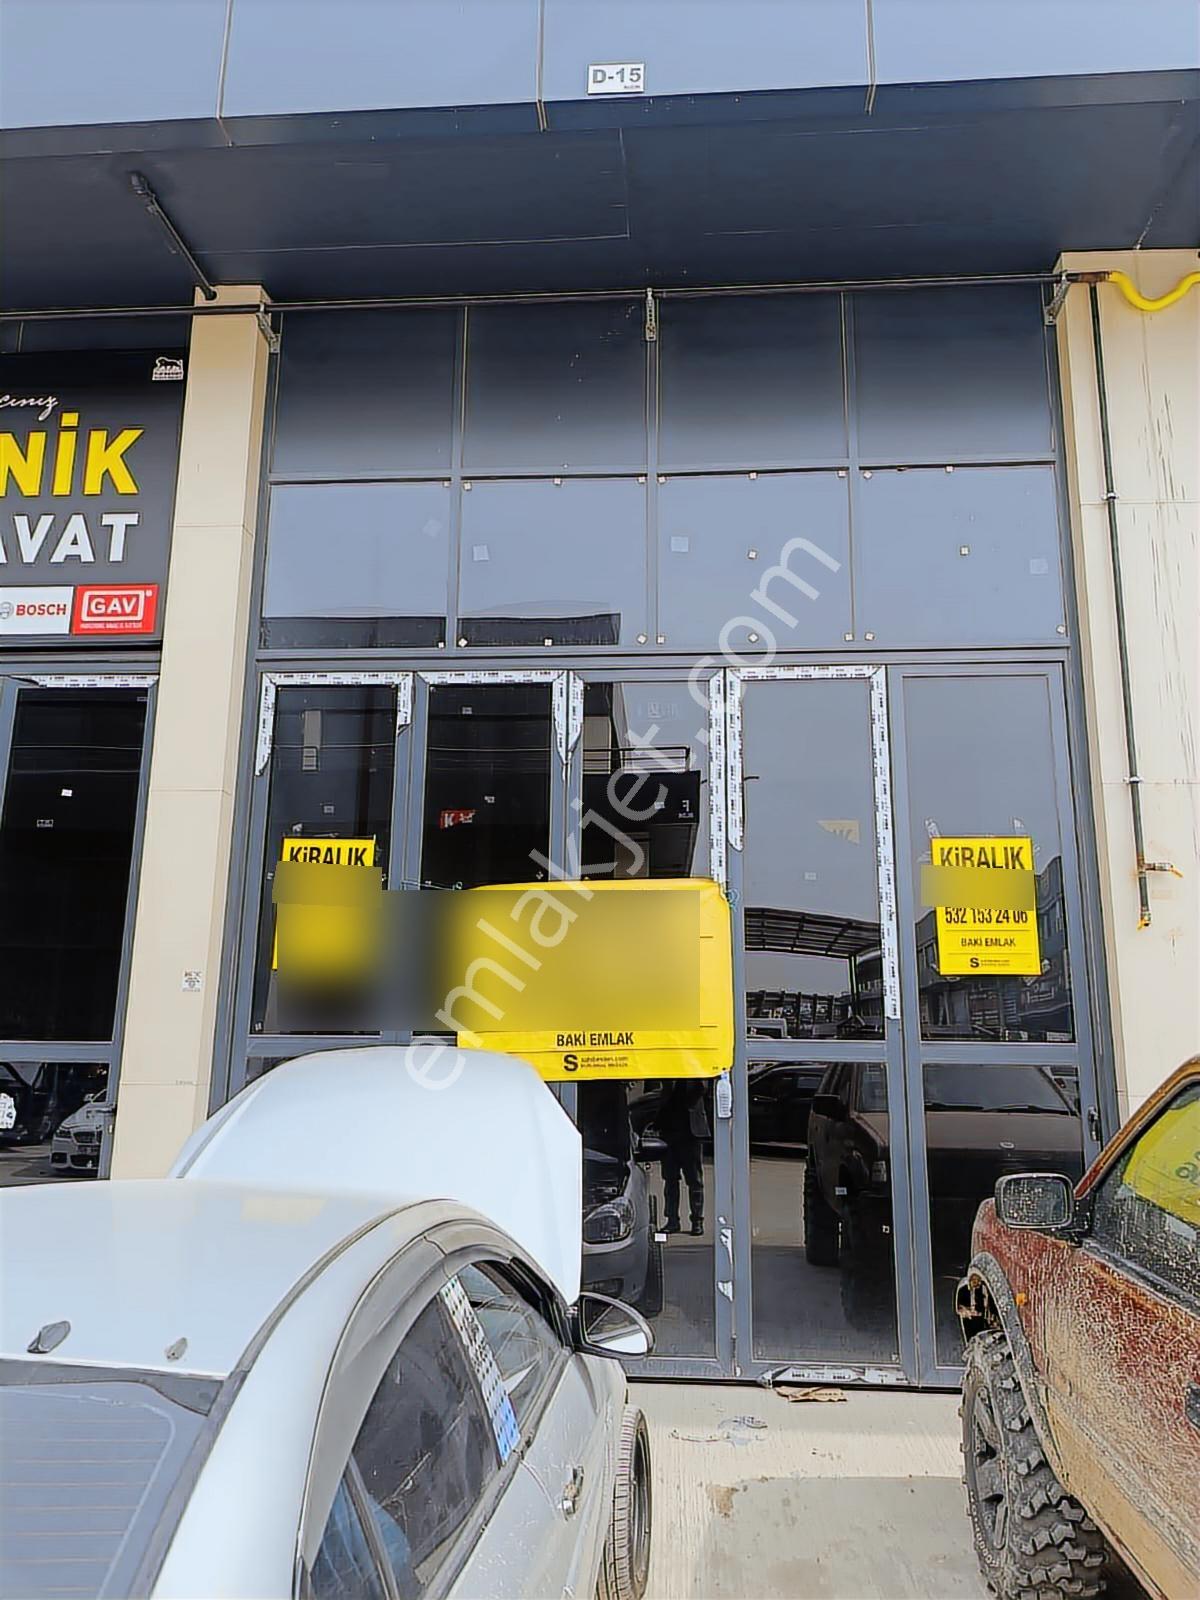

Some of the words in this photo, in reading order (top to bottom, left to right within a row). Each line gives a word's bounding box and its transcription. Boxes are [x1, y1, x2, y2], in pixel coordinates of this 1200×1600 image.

[592, 67, 641, 84] D-15
[0, 512, 140, 564] VAT
[16, 603, 67, 616] BOSCH
[90, 597, 137, 614] GAV
[985, 937, 1016, 947] EMLAK
[556, 1031, 586, 1047] BAKİ
[590, 1032, 634, 1046] EMLAK
[563, 1053, 579, 1072] S
